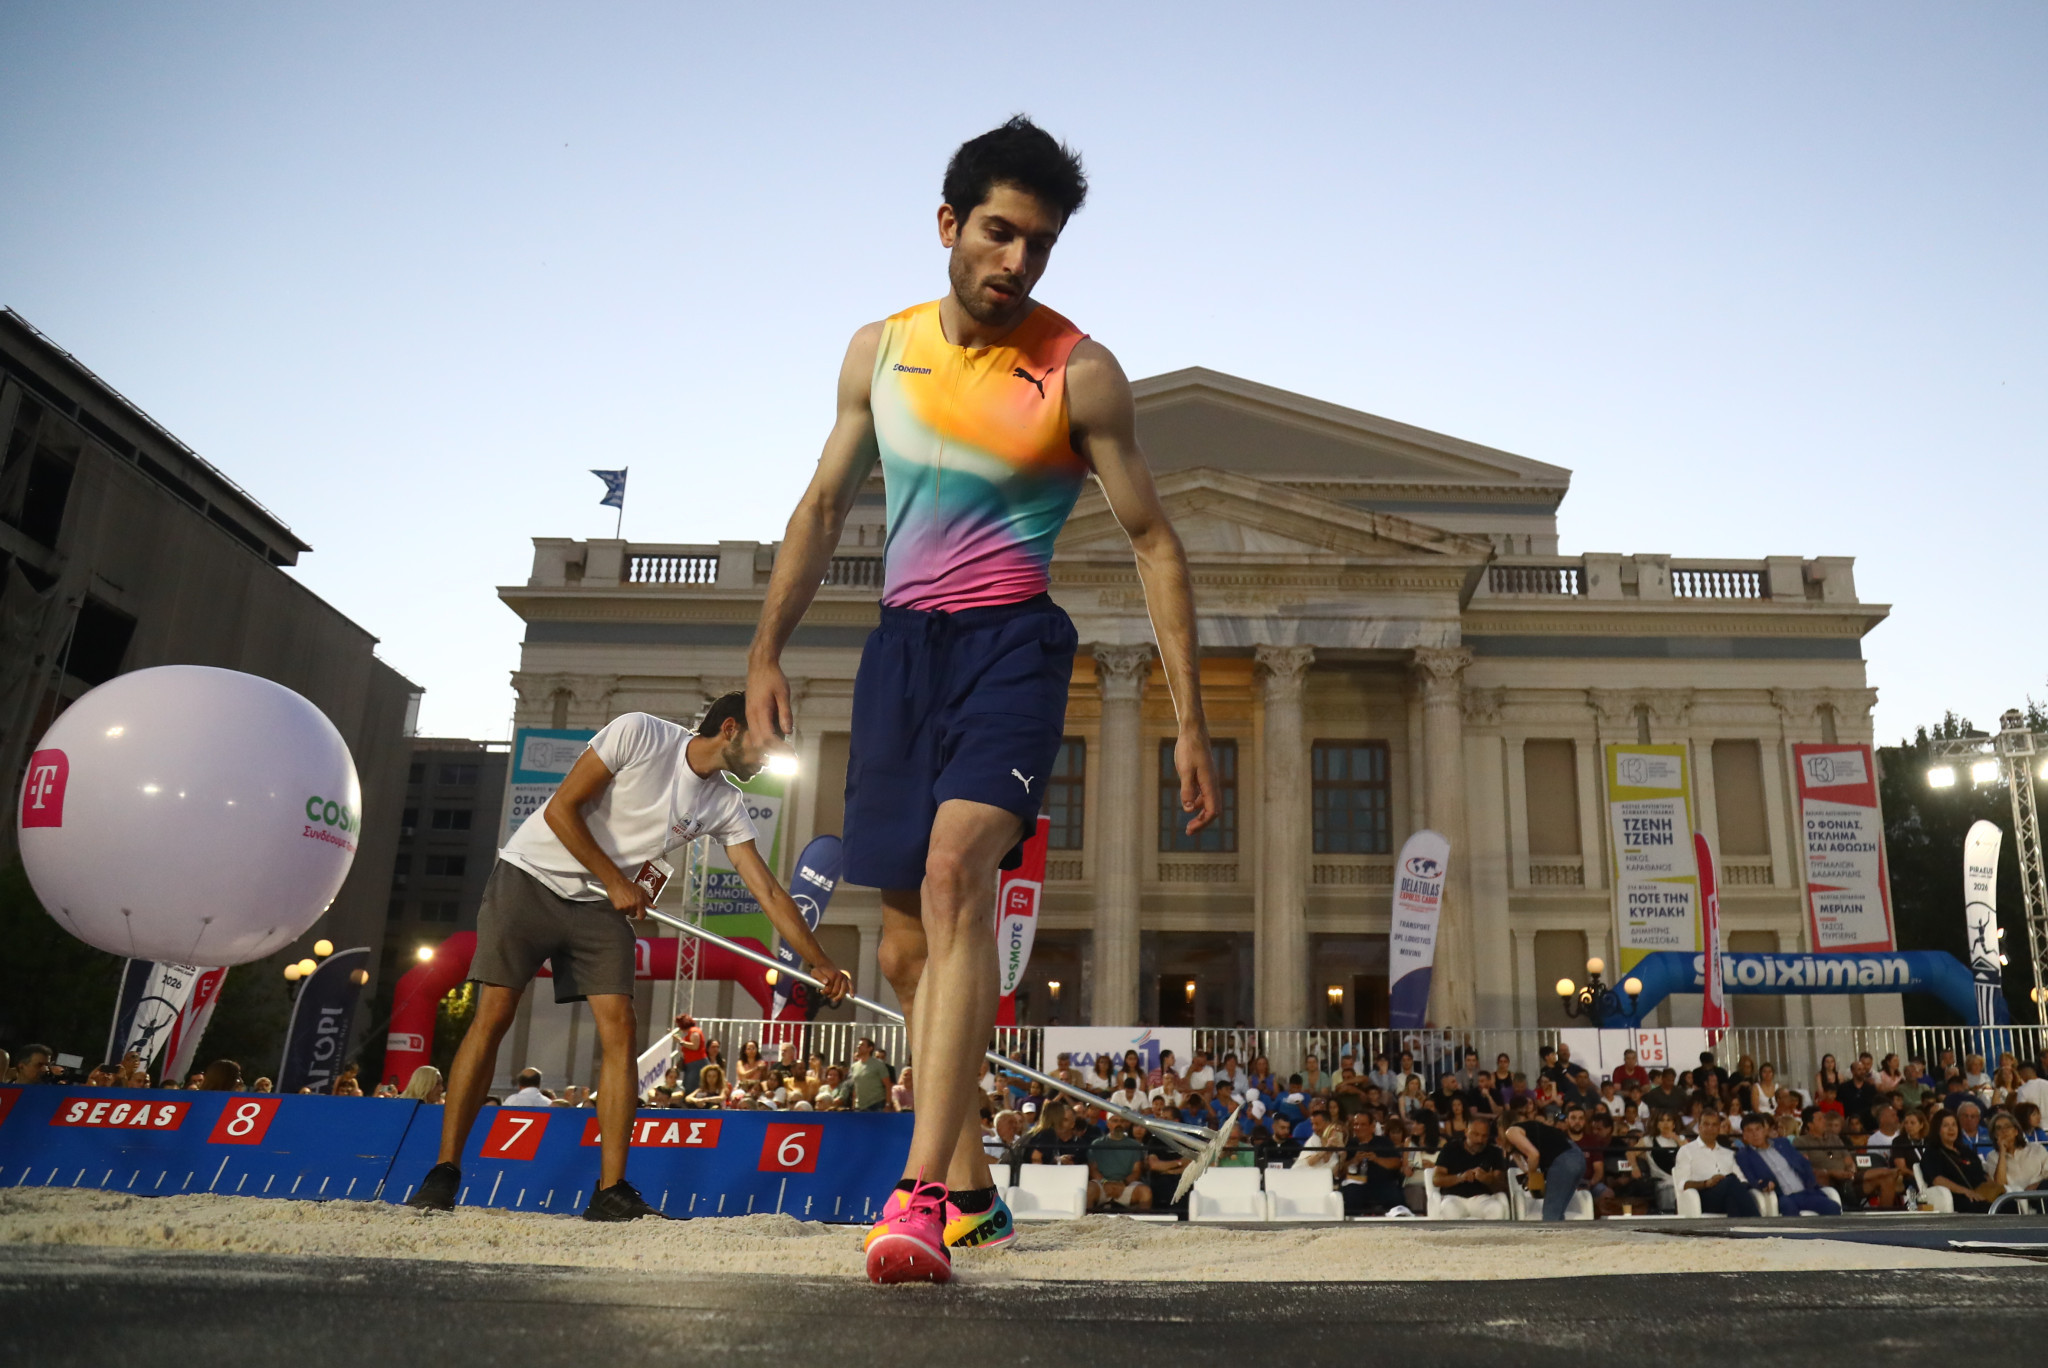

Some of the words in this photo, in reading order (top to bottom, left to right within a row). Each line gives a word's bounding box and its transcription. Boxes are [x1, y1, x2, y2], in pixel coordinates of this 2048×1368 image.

[1623, 818, 1672, 831] ΤΖΕΝΗ
[1624, 832, 1673, 845] ΤΖΕΝΗ
[1808, 832, 1856, 840] ΕΓΚΛΗΜΑ
[1810, 843, 1827, 852] ΚΑΙ
[1402, 878, 1440, 897] DELATOLAS
[1629, 893, 1660, 903] ΠΟΤΕ
[1663, 892, 1689, 903] ΤΗΝ
[1630, 907, 1685, 917] ΚΥΡΙΑΚΗ
[1820, 904, 1863, 913] ΜΕΡΙΛΙΝ
[66, 1101, 177, 1127] SEGAS
[227, 1103, 261, 1136] 8
[500, 1118, 534, 1151] 7
[594, 1121, 706, 1144] ΓΑΣ
[778, 1132, 806, 1167] 6
